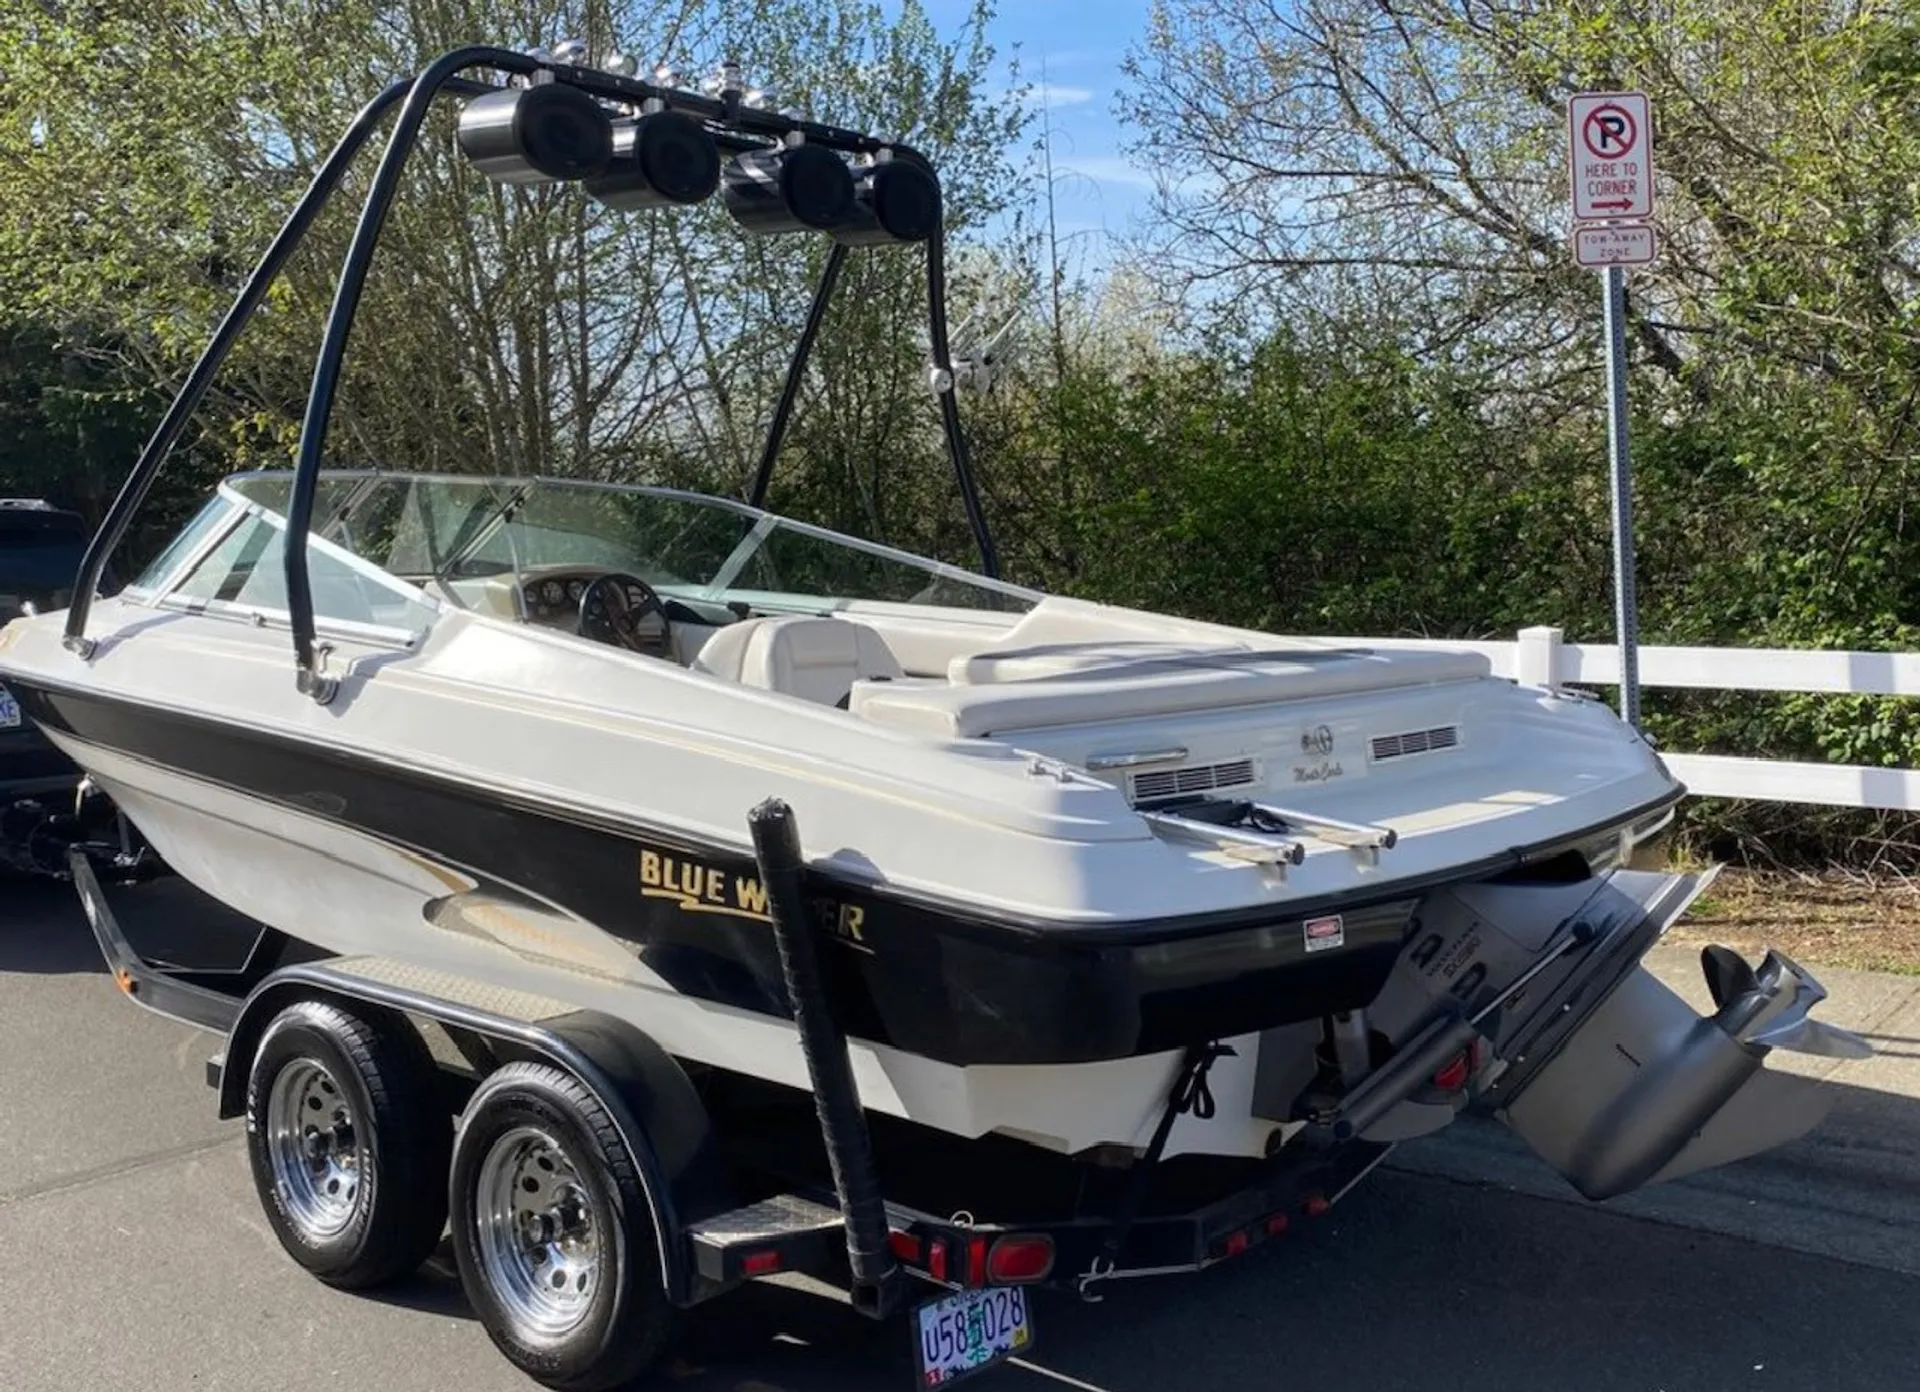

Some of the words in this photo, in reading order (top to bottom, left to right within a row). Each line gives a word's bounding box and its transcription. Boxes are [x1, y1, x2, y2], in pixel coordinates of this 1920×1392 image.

[1585, 162, 1618, 178] HERE
[1623, 162, 1638, 177] TO
[1587, 179, 1638, 197] CORNER
[640, 849, 726, 904] BLUE
